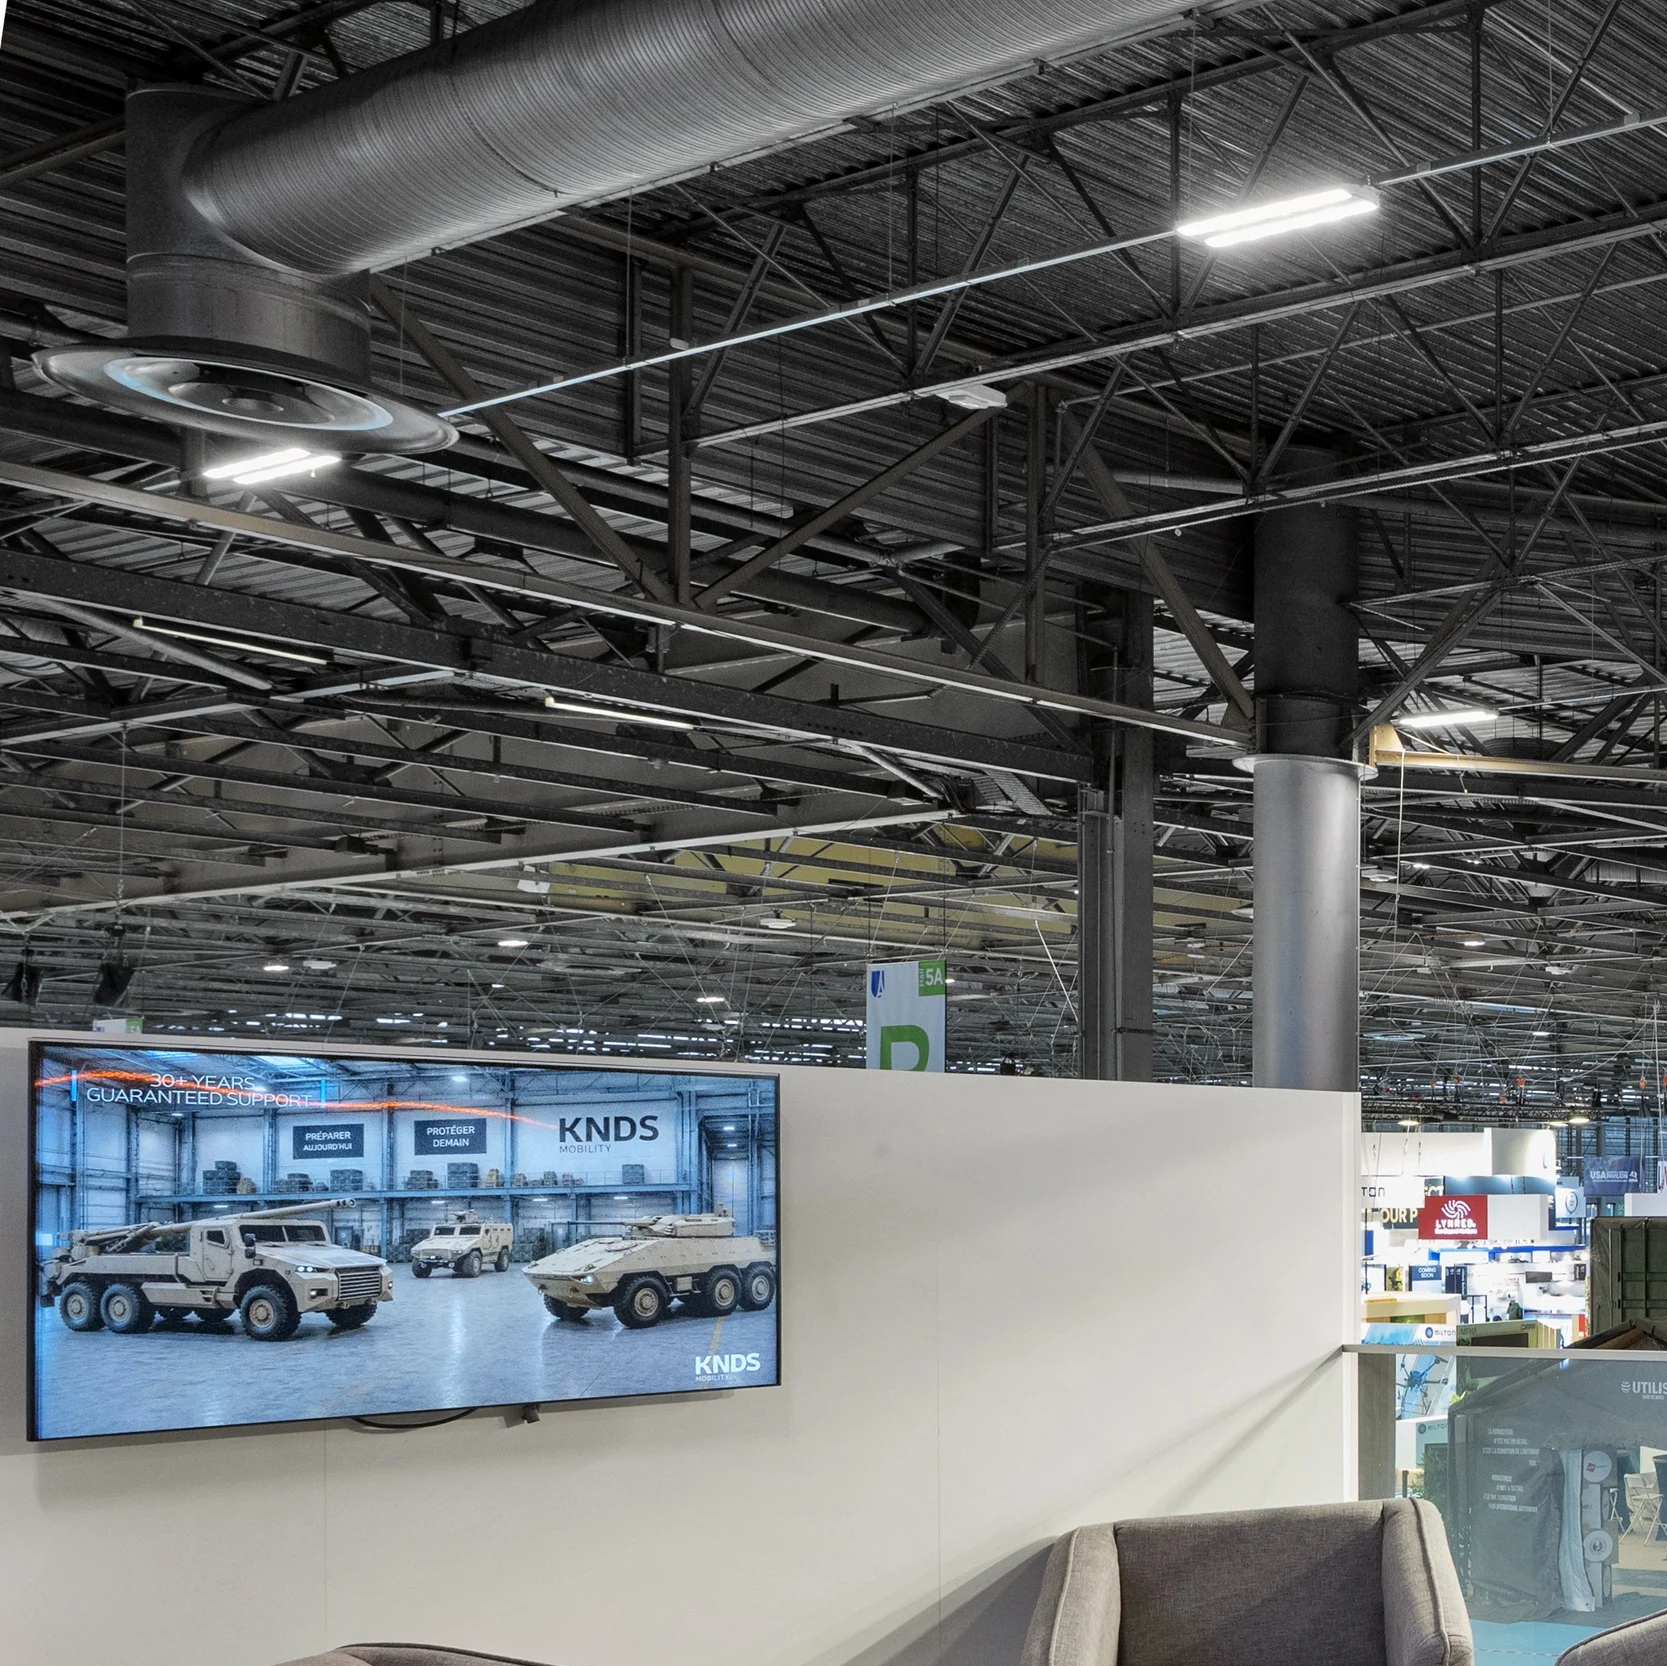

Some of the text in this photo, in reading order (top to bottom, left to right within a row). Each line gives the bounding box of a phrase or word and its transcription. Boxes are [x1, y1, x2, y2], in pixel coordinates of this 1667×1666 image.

[926, 968, 944, 986] 5A
[150, 1073, 256, 1091] 30+ YEARS
[86, 1087, 313, 1108] GUARANTEED SUPPORT
[305, 1130, 351, 1141] PRÉPARER
[426, 1124, 475, 1136] PROTÉGER
[559, 1115, 660, 1143] KNDS
[432, 1137, 469, 1148] DEMAIN
[559, 1144, 612, 1153] MOBILITY
[1590, 1171, 1606, 1179] USA
[695, 1352, 761, 1375] KNDS
